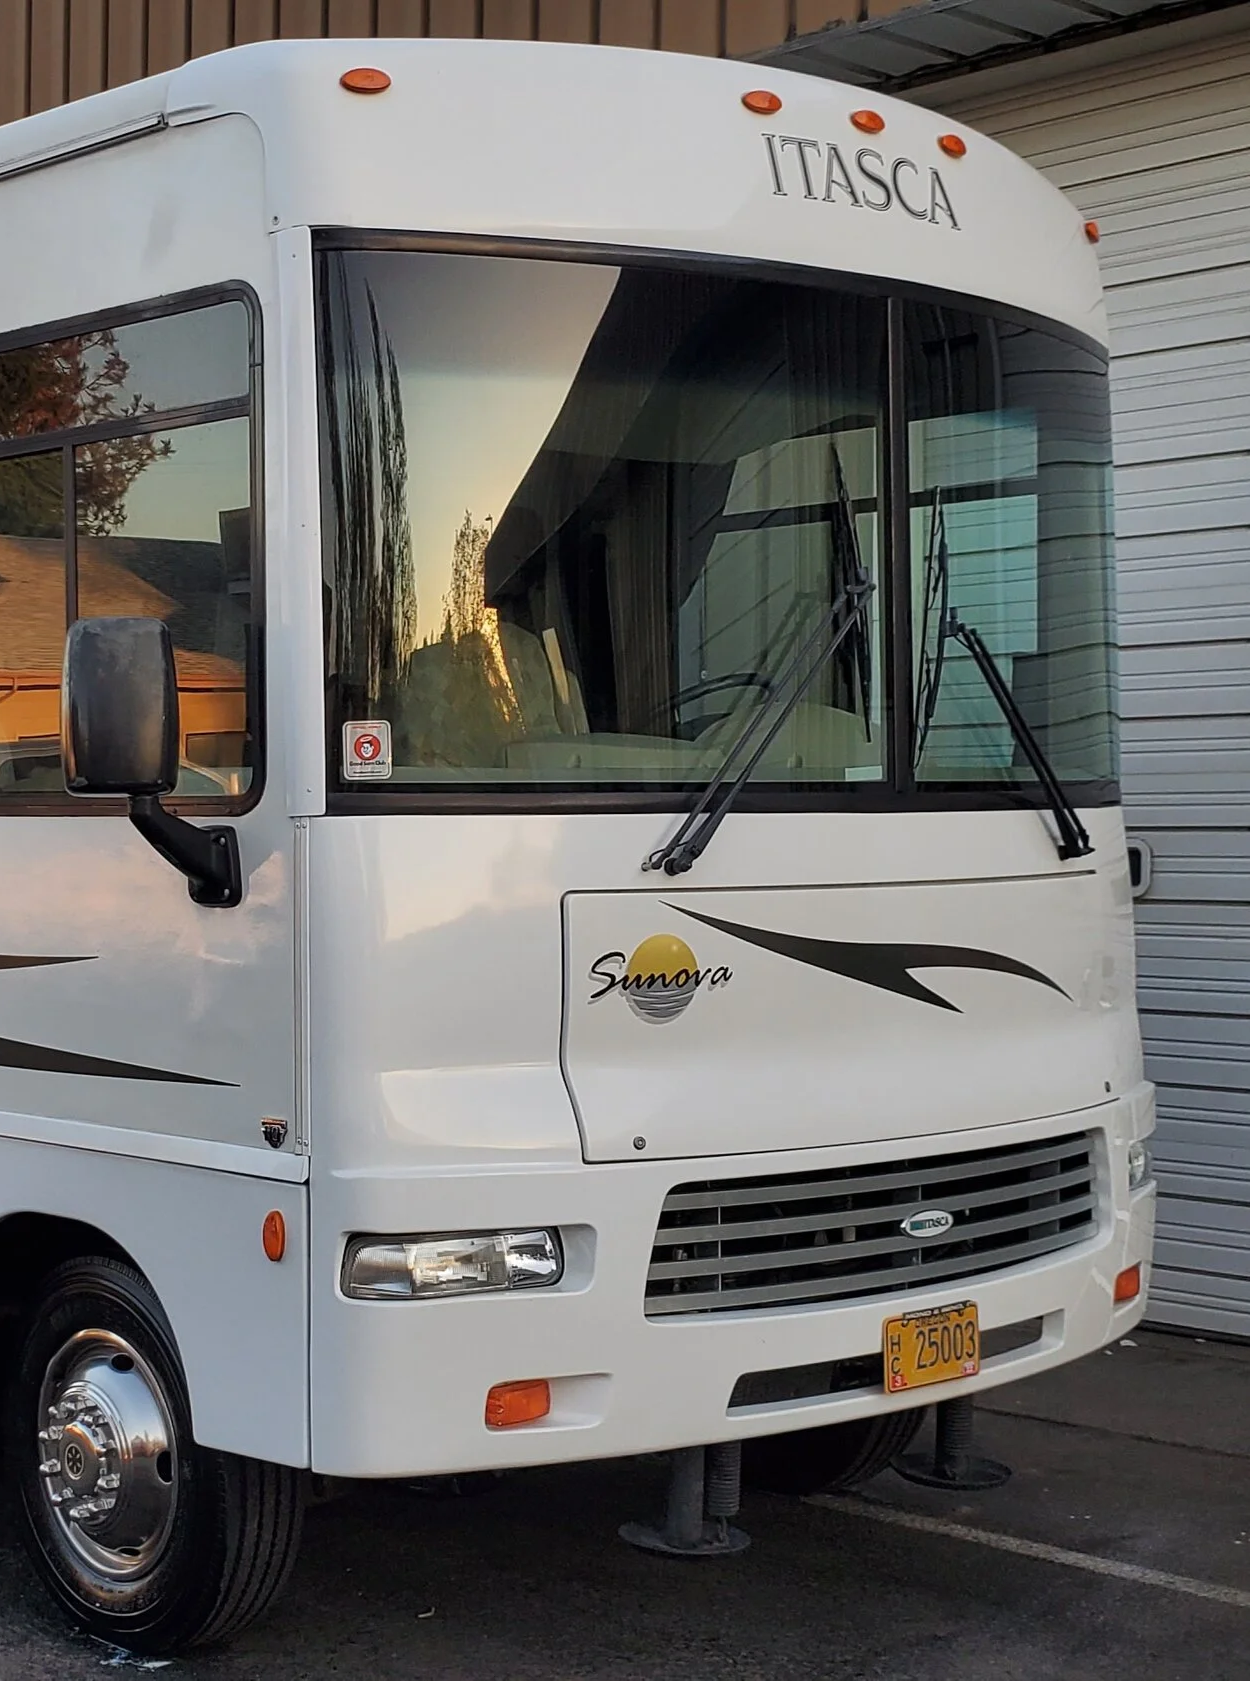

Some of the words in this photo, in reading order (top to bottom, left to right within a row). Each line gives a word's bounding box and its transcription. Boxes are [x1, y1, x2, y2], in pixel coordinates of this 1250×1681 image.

[761, 133, 962, 231] ITASCA
[590, 951, 734, 999] Sunova
[915, 1319, 977, 1370] 25003
